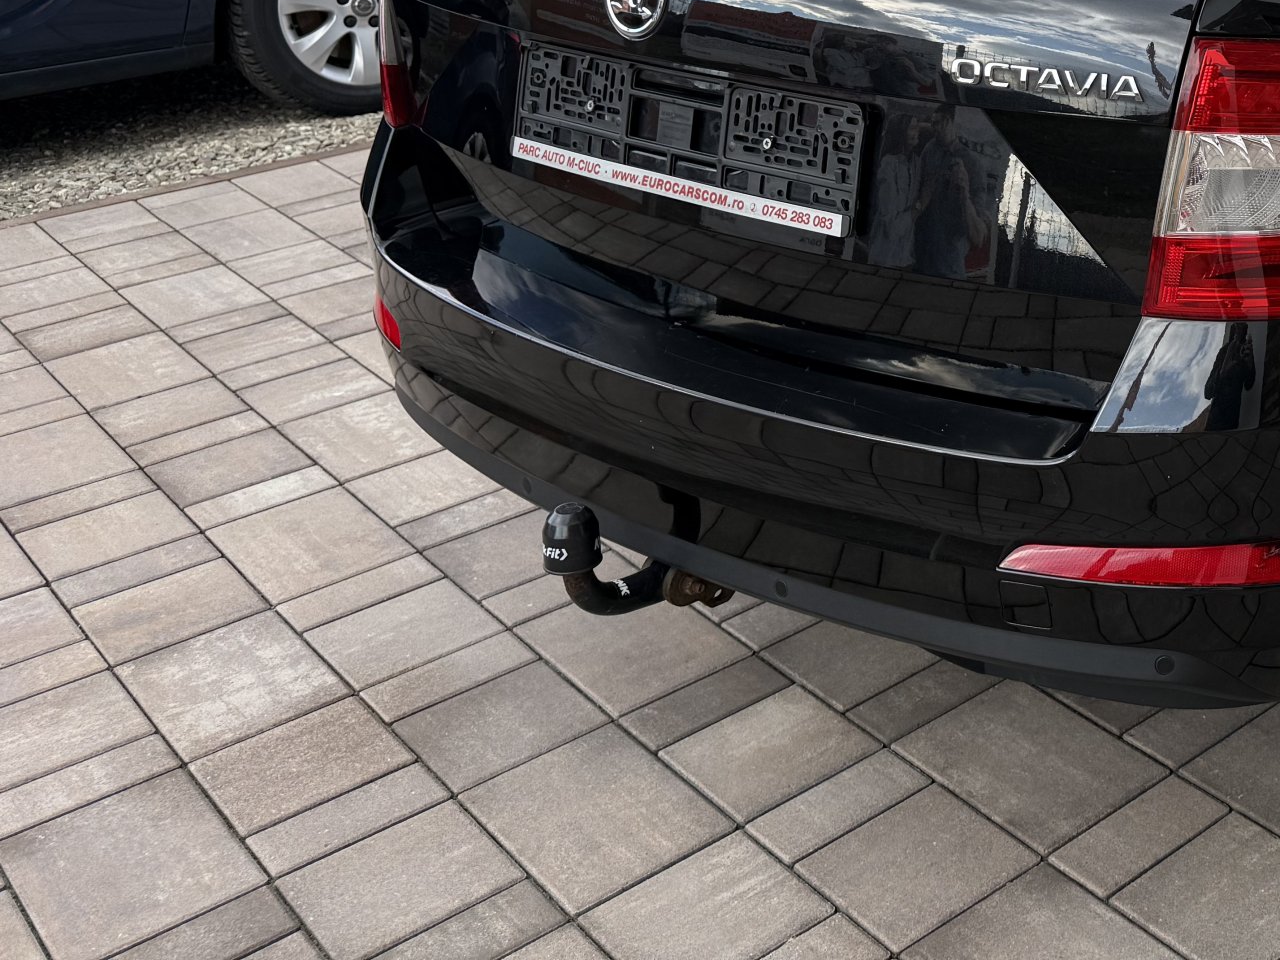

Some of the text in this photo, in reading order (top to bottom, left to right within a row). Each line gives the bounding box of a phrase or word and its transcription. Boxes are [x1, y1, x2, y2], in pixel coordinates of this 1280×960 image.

[951, 58, 1144, 102] OCTAVIA
[518, 143, 541, 158] PARC
[541, 149, 565, 165] AUTO
[566, 156, 601, 175] M-CIUC
[761, 204, 789, 220] 0745
[790, 210, 811, 225] 283
[812, 215, 834, 230] 083
